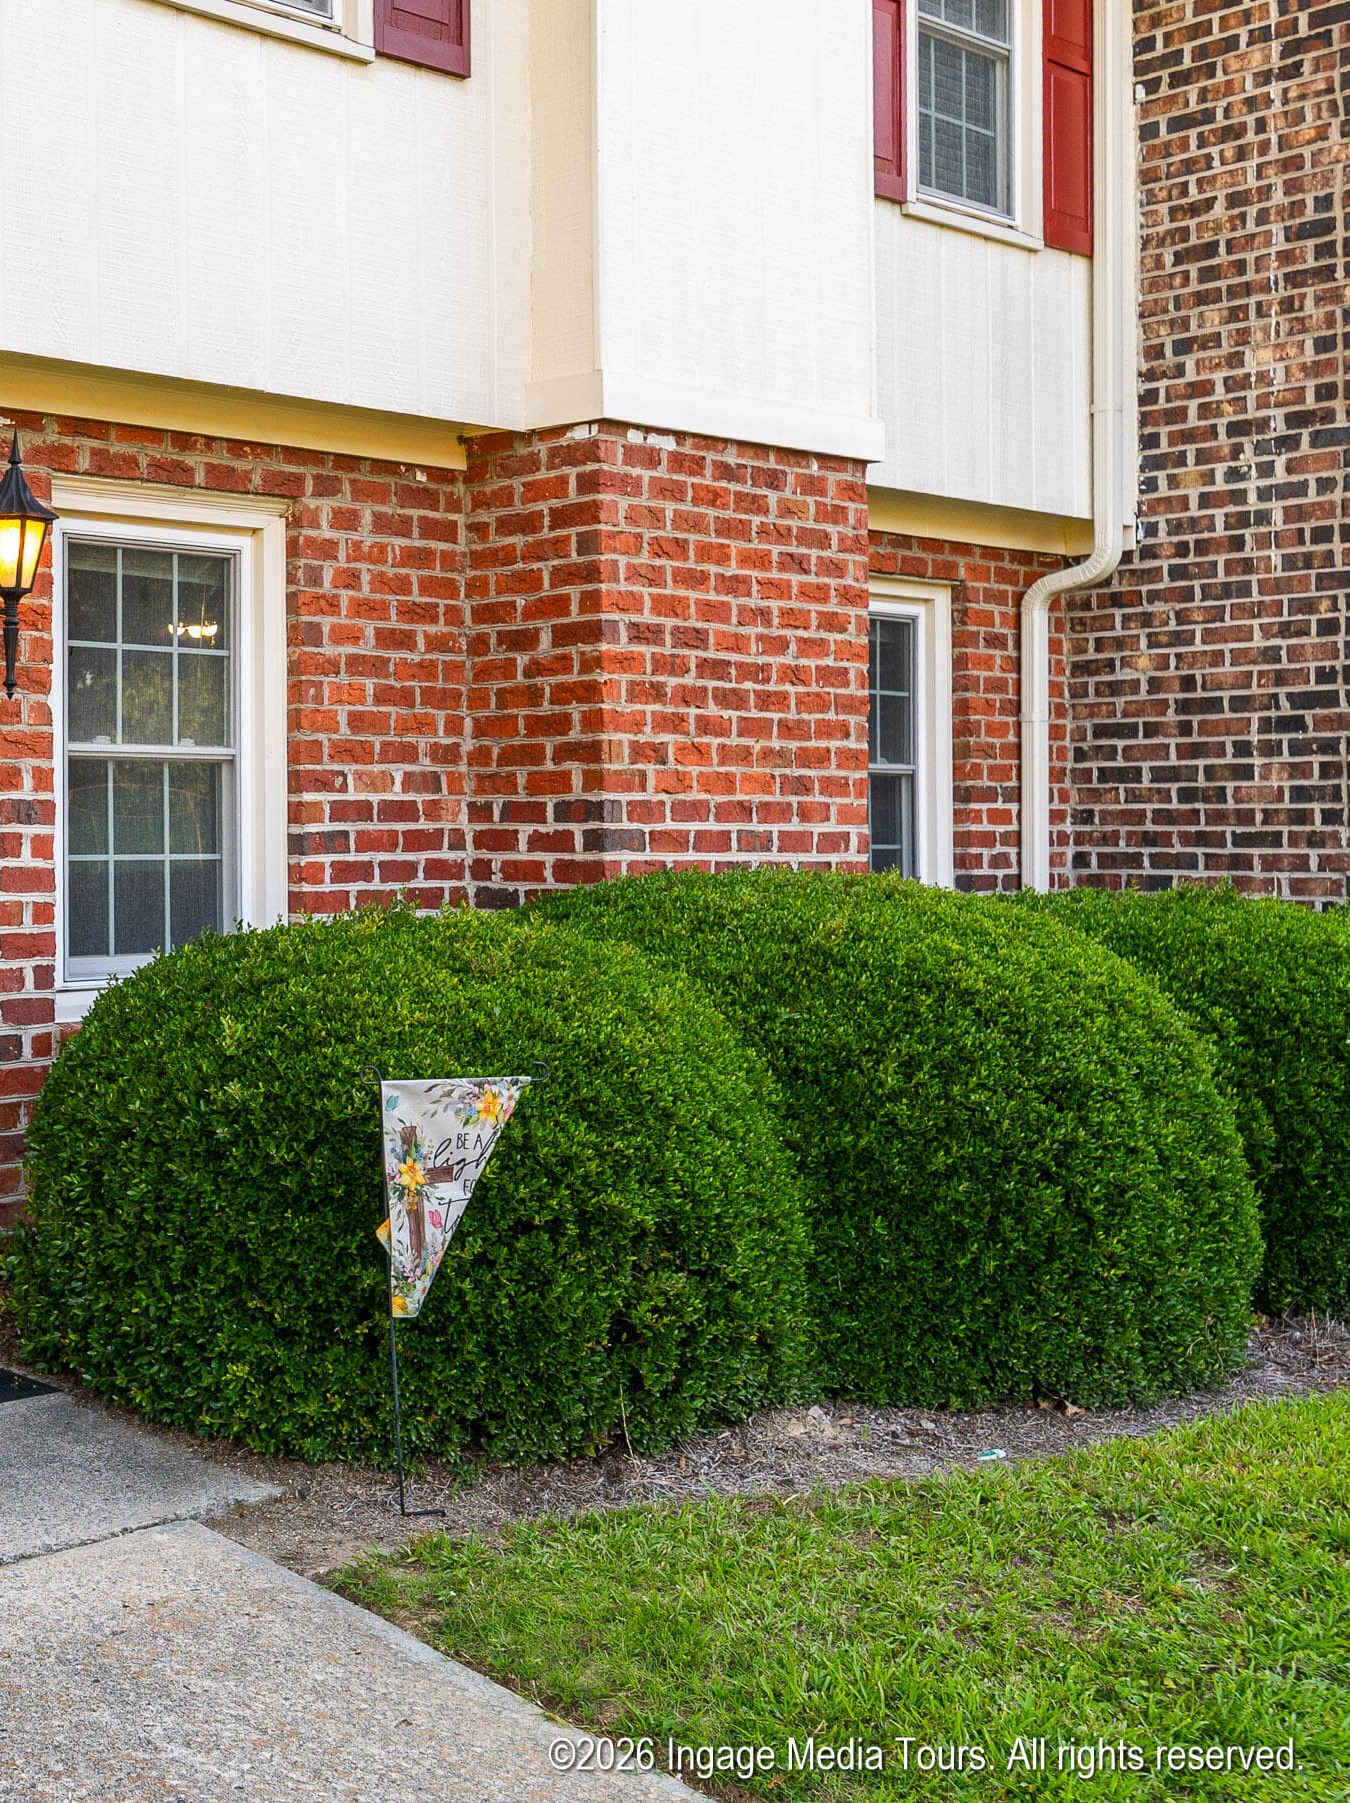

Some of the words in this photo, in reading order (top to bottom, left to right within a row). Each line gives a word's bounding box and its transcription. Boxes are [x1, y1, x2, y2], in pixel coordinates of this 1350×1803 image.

[433, 1128, 497, 1181] ligh
[456, 1133, 470, 1150] BE
[473, 1133, 484, 1150] A
